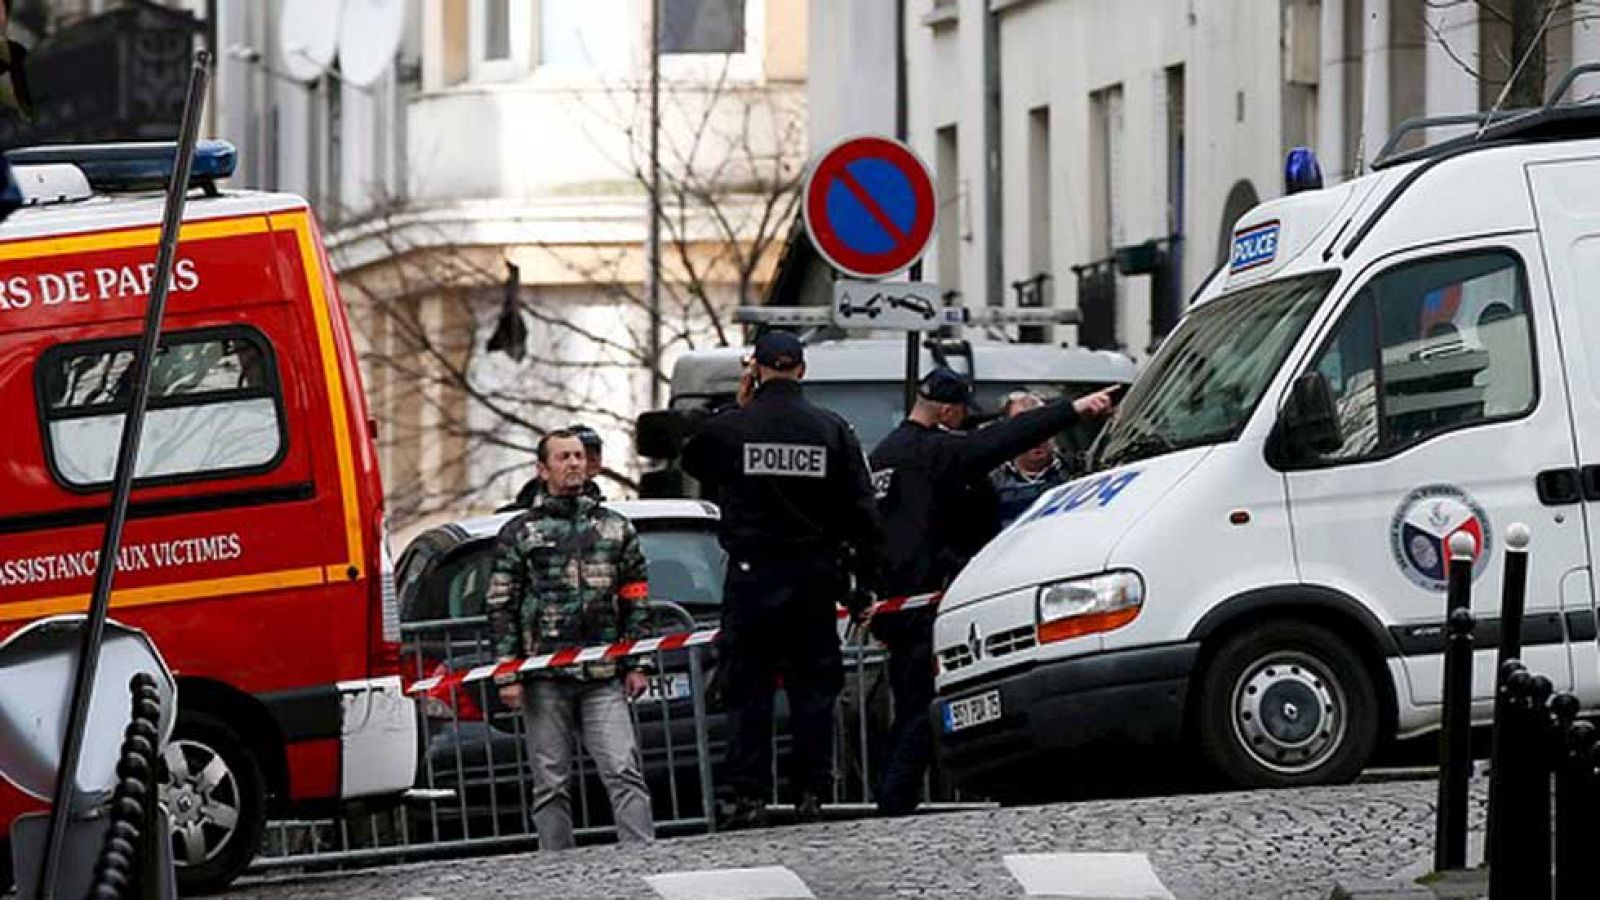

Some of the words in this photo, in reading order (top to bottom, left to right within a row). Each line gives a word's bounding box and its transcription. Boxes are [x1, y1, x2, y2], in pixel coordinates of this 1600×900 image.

[1233, 231, 1276, 260] POLICE
[37, 270, 90, 305] DE
[749, 448, 822, 472] POLICE
[151, 532, 242, 567] VICTIMES
